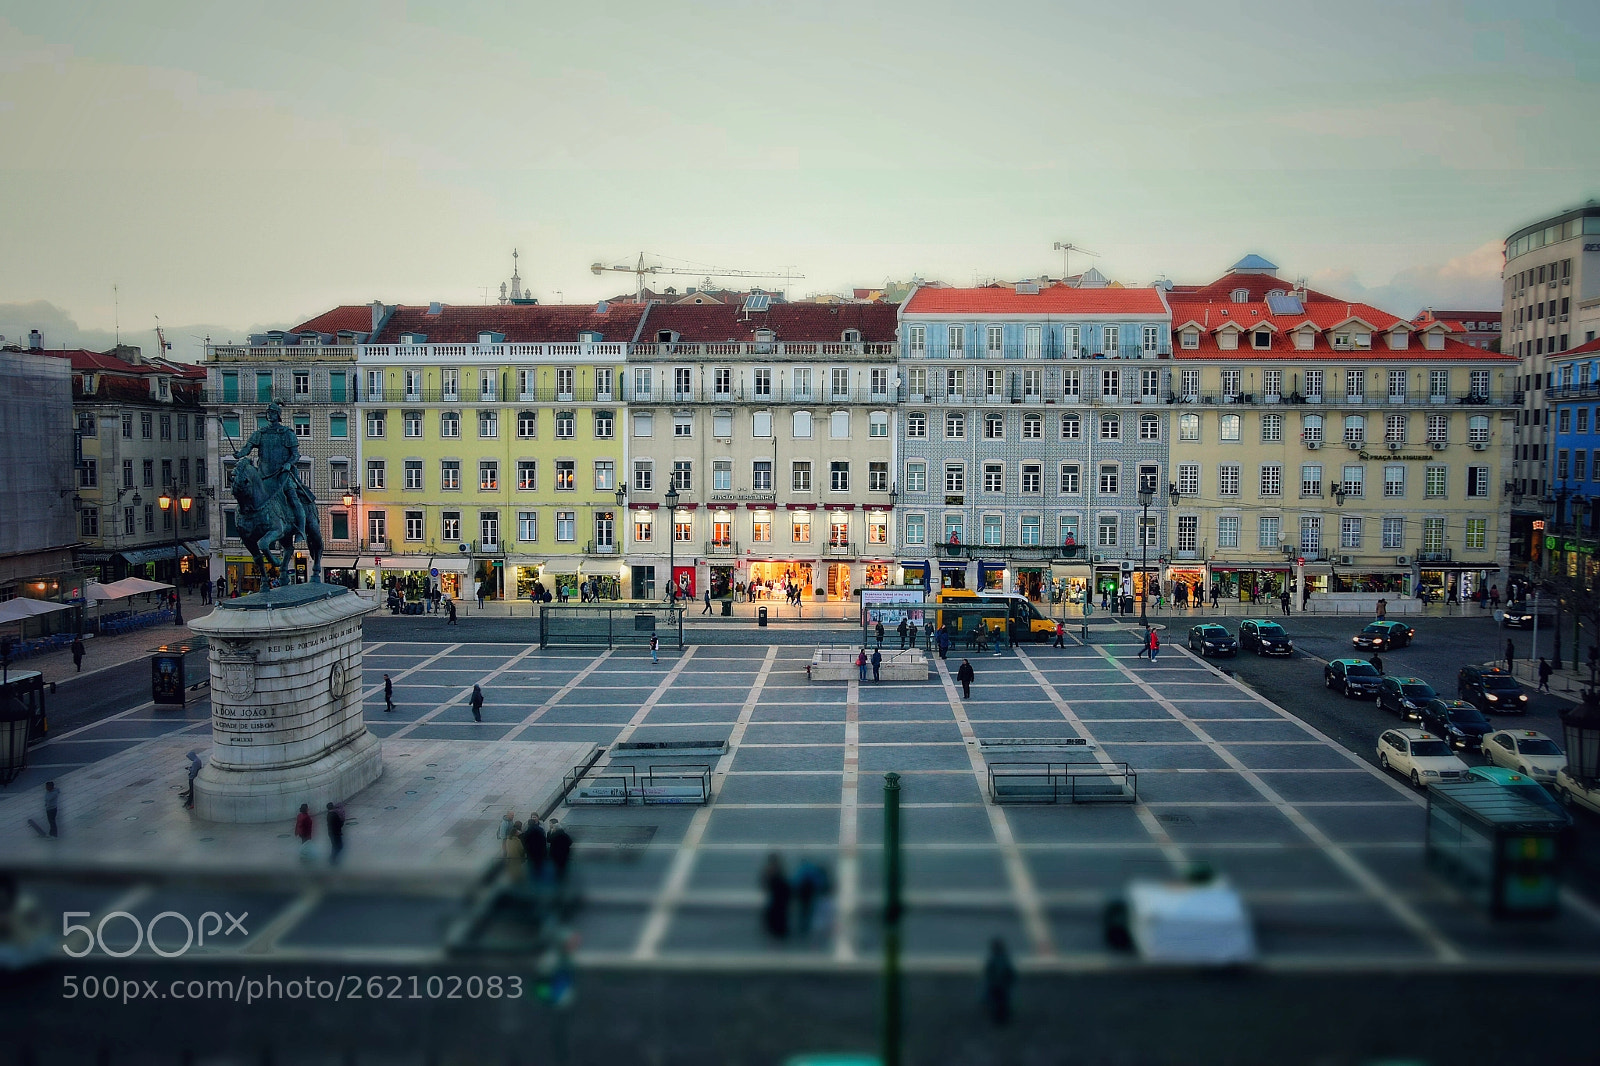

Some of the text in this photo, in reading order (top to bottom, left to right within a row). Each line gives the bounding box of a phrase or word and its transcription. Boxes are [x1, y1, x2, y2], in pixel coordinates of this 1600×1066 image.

[268, 645, 281, 653] REI
[285, 644, 295, 652] DE
[220, 708, 237, 717] DOM
[241, 708, 267, 717] JOÃO
